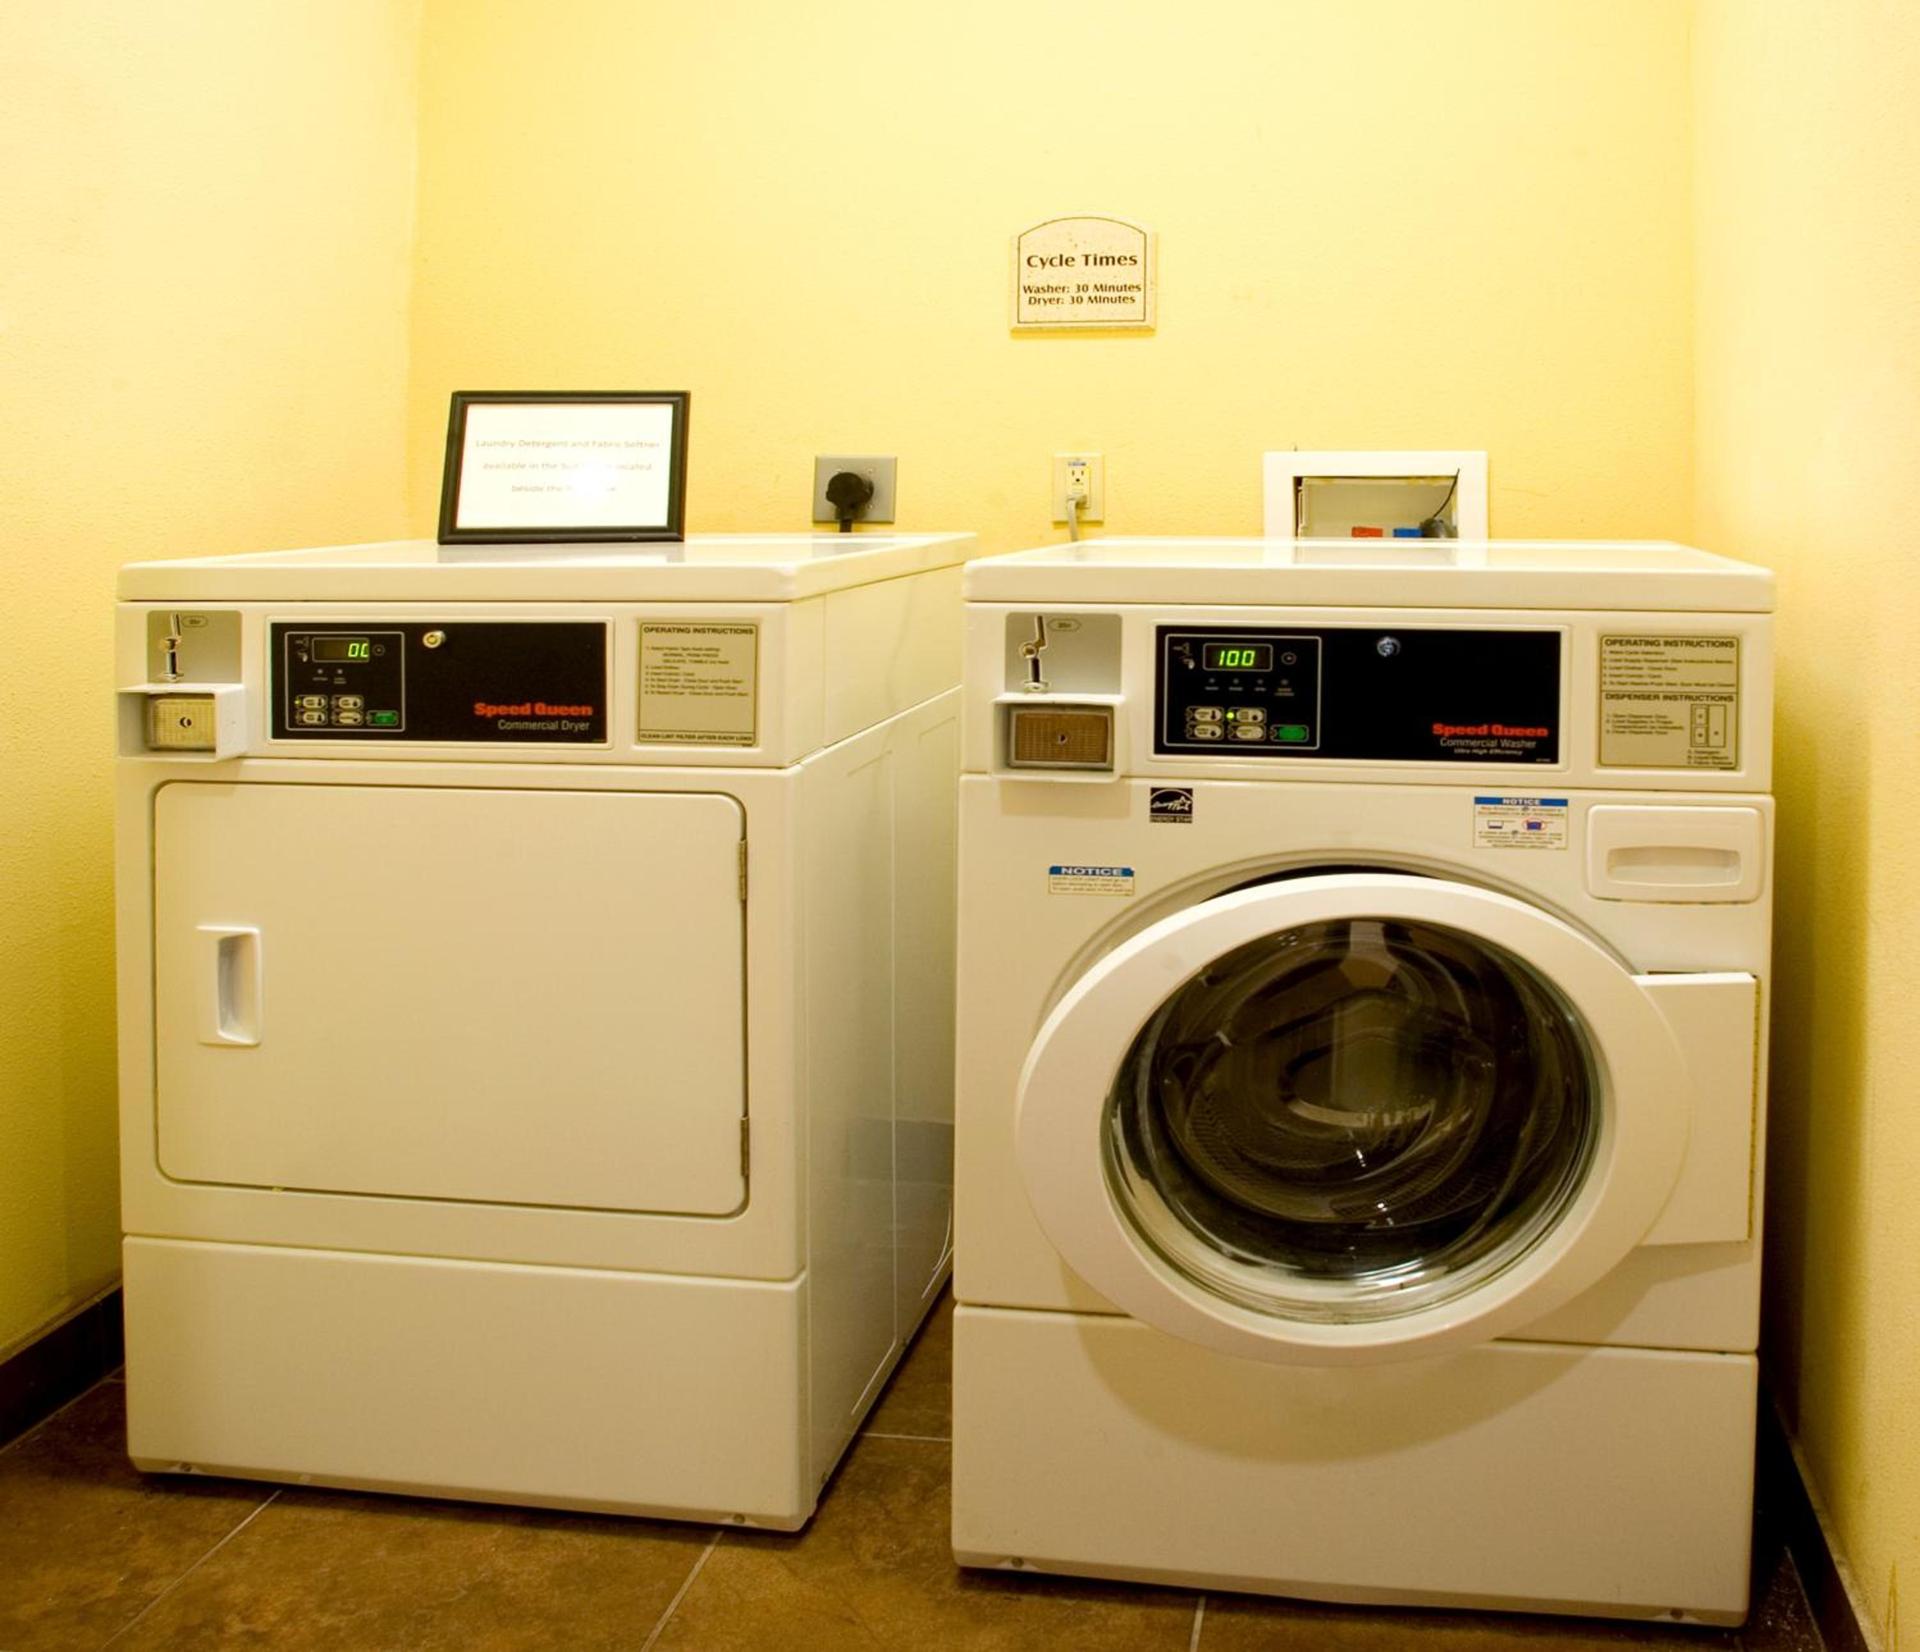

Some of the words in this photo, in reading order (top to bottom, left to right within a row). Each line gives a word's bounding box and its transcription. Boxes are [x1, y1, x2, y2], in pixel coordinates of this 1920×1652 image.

[1026, 254, 1076, 269] Cycle
[1081, 254, 1138, 266] Times
[1023, 284, 1070, 294] Washer:
[1074, 284, 1089, 293] 30
[1093, 283, 1142, 292] Minutes
[1028, 296, 1065, 306] Dryer:
[1069, 295, 1083, 304] 30
[1086, 295, 1136, 304] Minutes
[476, 440, 515, 448] Laundry
[643, 626, 690, 634] OPERATING
[693, 627, 754, 635] INSTRUCTIONS
[1604, 639, 1661, 647] OPERATING
[1663, 639, 1735, 648] INSTRUCTIONS
[1218, 650, 1256, 666] 100
[1604, 693, 1661, 701] DISPENSER
[1663, 694, 1734, 702] INSTRUCTIONS
[474, 702, 532, 717] Speed
[534, 702, 593, 716] Queen
[498, 719, 558, 730] Commercial
[561, 720, 590, 732] Dryer
[1432, 723, 1489, 737] Speed
[1491, 724, 1549, 737] Queen
[1440, 737, 1498, 747] Commercial
[1500, 739, 1537, 748] Washer
[1502, 798, 1540, 806] NOTICE
[1060, 867, 1122, 876] NOTICE
